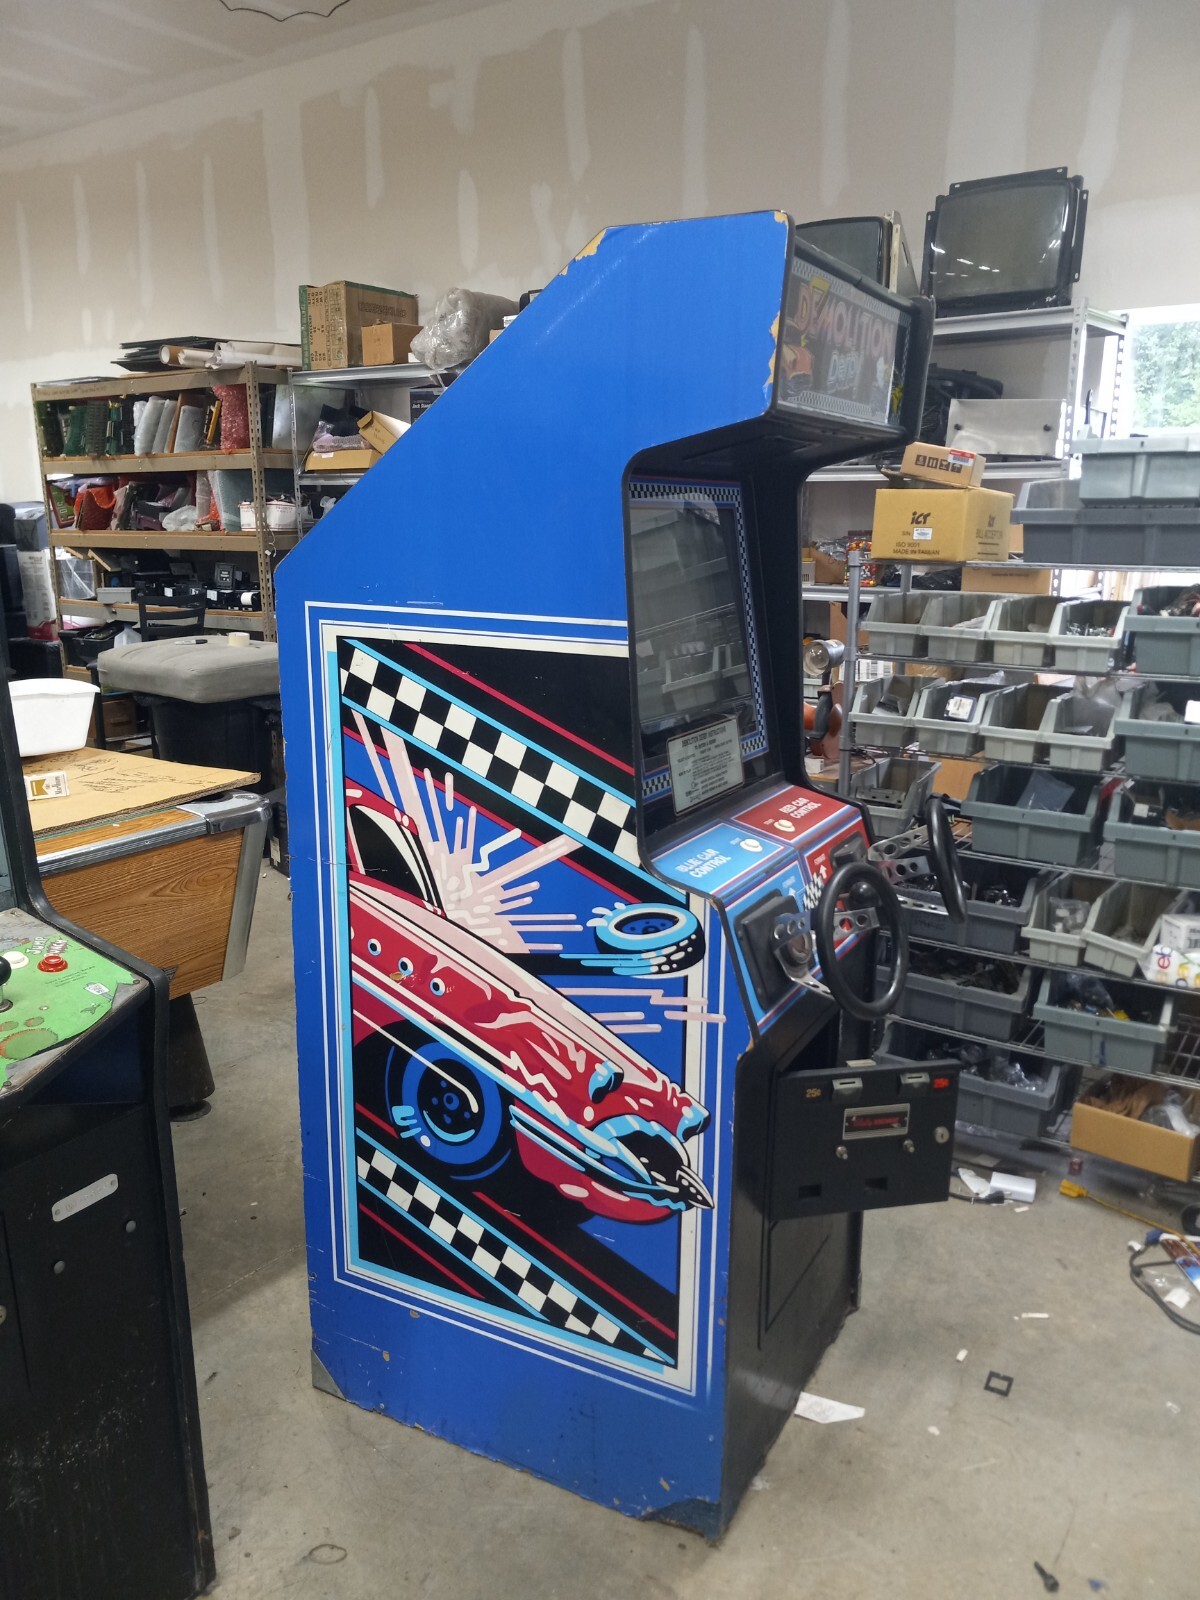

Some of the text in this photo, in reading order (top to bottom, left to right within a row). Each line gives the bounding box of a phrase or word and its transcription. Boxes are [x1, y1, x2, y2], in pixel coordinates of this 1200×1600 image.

[796, 282, 897, 360] DEMOLITION
[827, 350, 868, 394] Derby
[778, 797, 810, 814] RED CAR
[789, 802, 822, 819] CONTROL
[675, 848, 720, 873] BLUE CAR
[689, 855, 732, 878] CONTROL
[25, 936, 49, 955] JUMP
